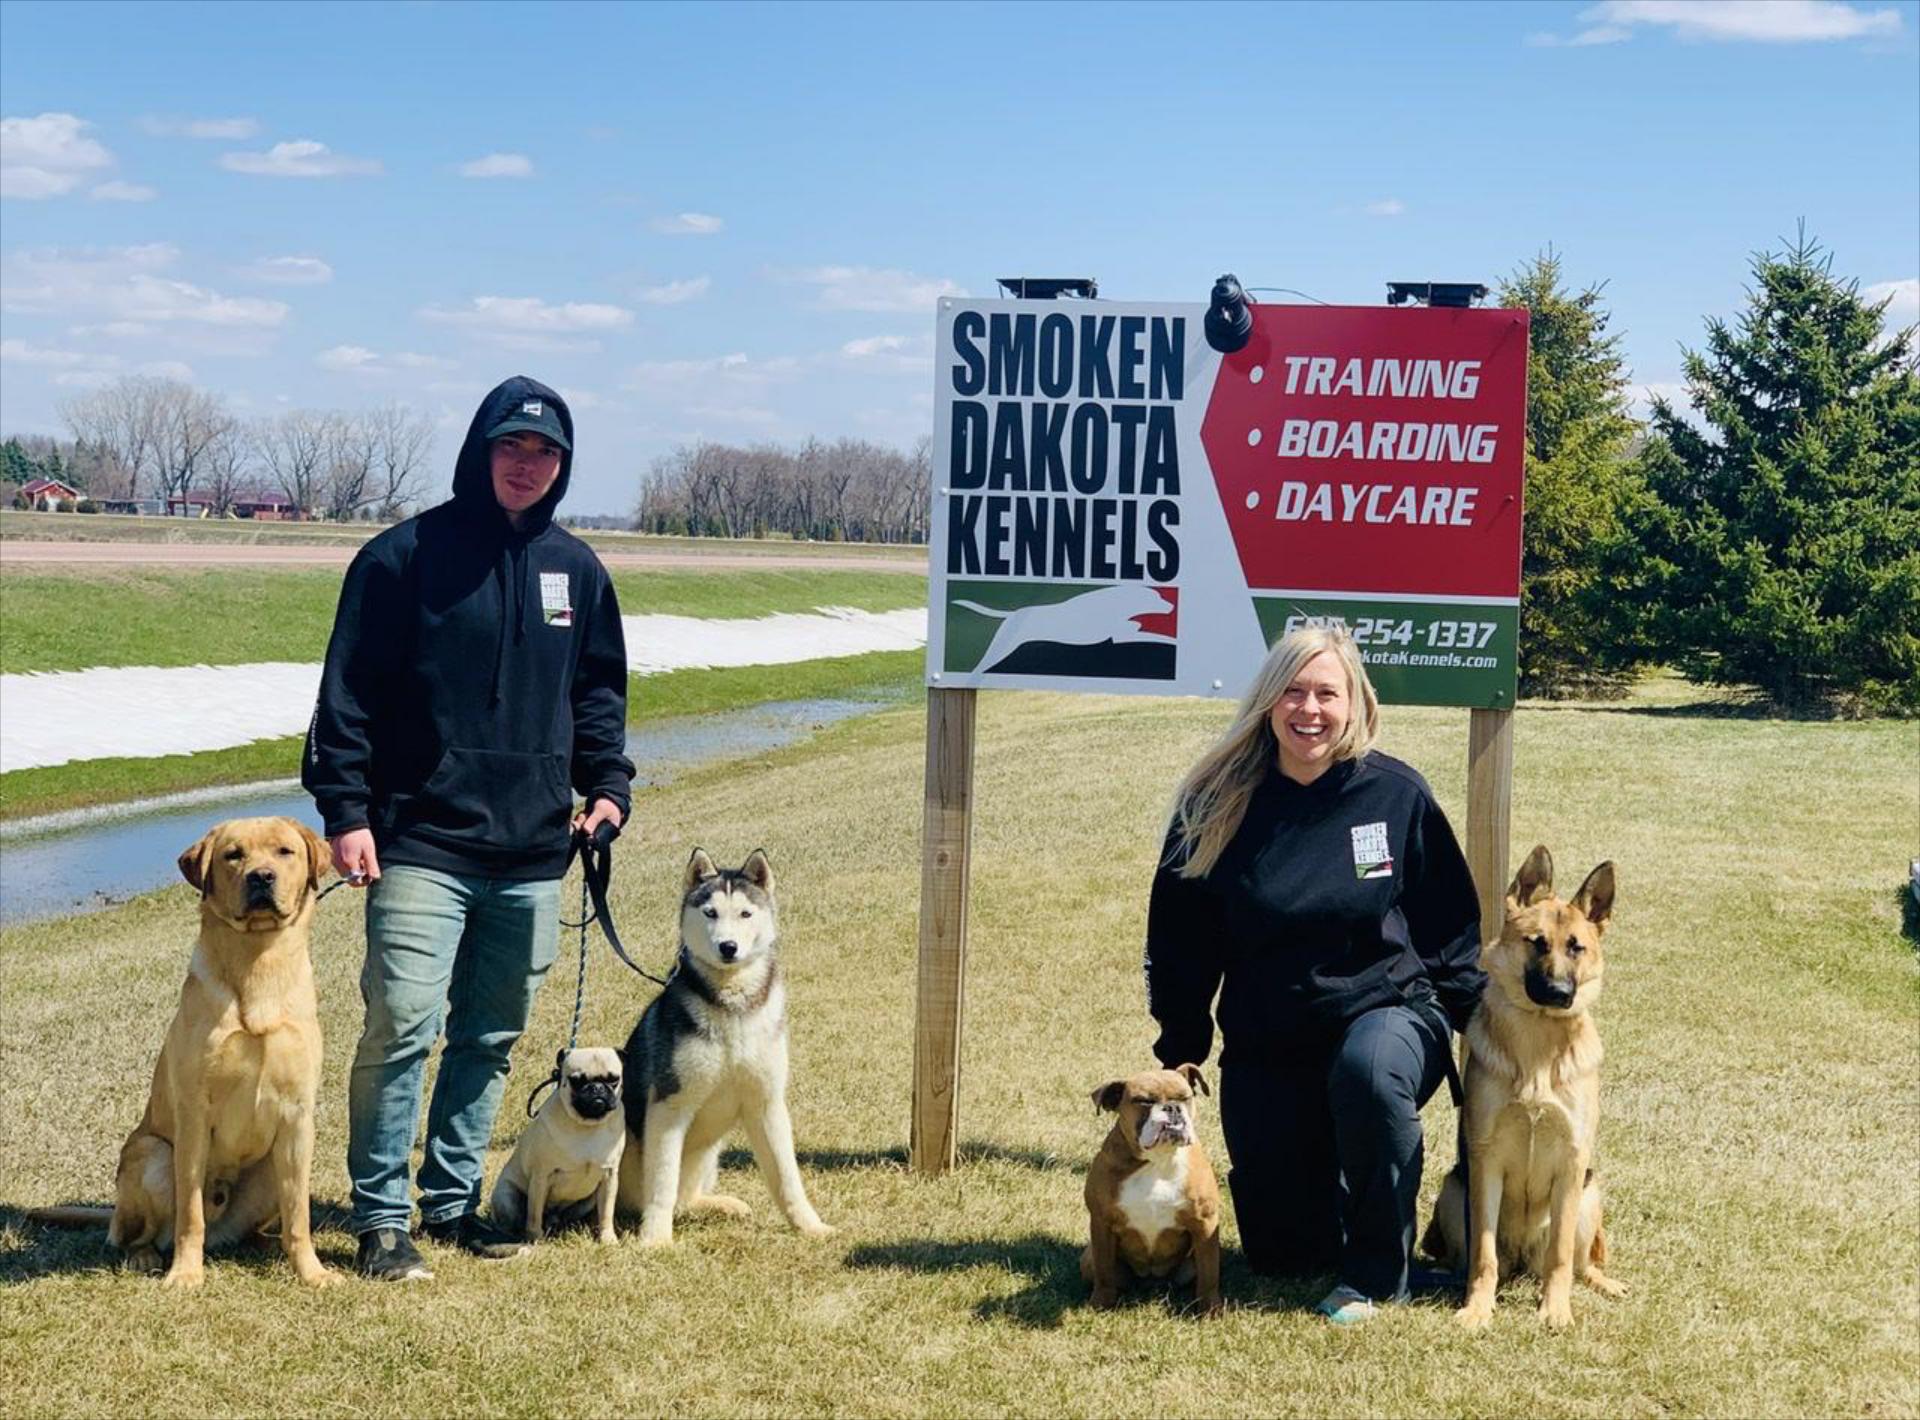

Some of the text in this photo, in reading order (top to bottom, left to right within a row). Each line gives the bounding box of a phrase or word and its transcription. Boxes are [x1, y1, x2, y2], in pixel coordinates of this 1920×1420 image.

[952, 311, 1185, 400] SMOKEN
[1285, 356, 1481, 400] TRAINING
[950, 401, 1180, 496] DAKOTA
[1277, 419, 1499, 463] BOARDING
[1276, 481, 1479, 526] DAYCARE
[947, 495, 1180, 582] KENNELS
[1360, 649, 1498, 669] kotaKennels.com
